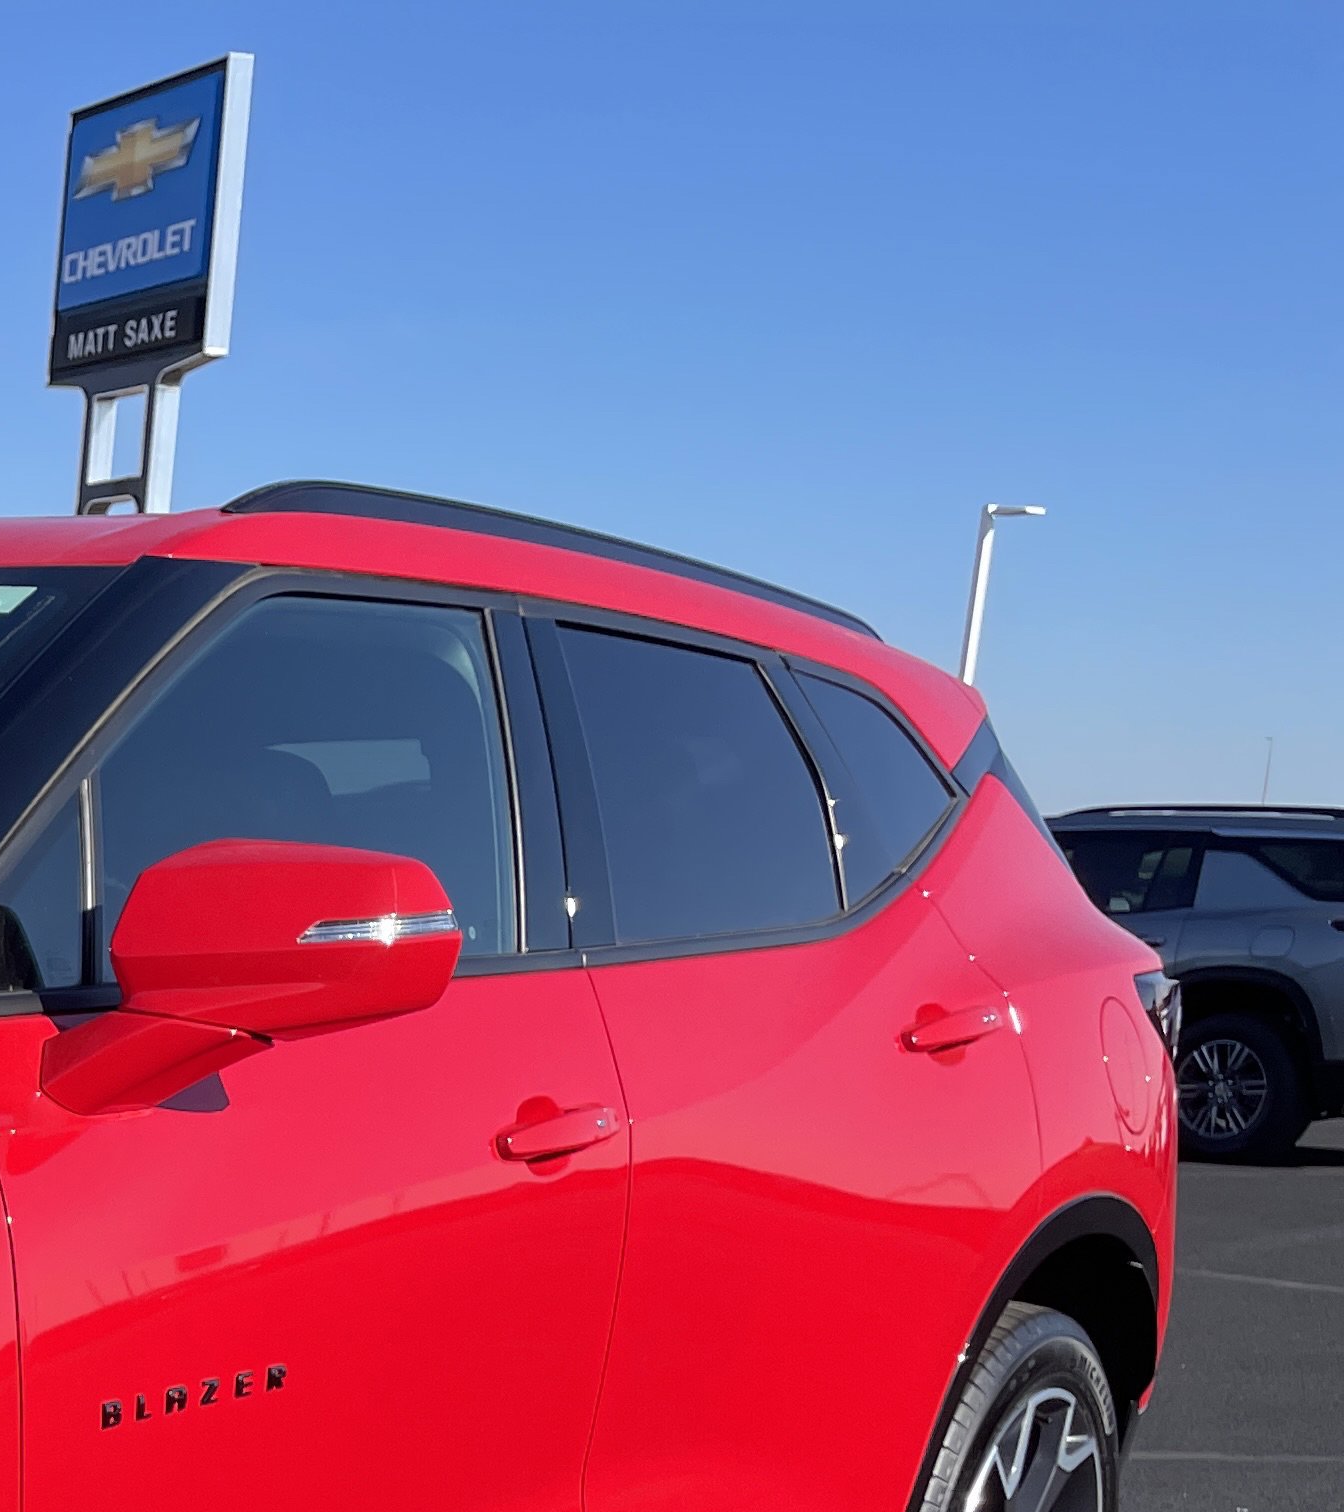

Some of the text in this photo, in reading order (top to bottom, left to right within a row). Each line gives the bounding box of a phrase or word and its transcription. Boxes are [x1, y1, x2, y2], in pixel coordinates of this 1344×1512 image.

[63, 219, 196, 284] CHEVROLET
[69, 310, 178, 360] MATT SAXE
[100, 1364, 287, 1430] BLAZER
